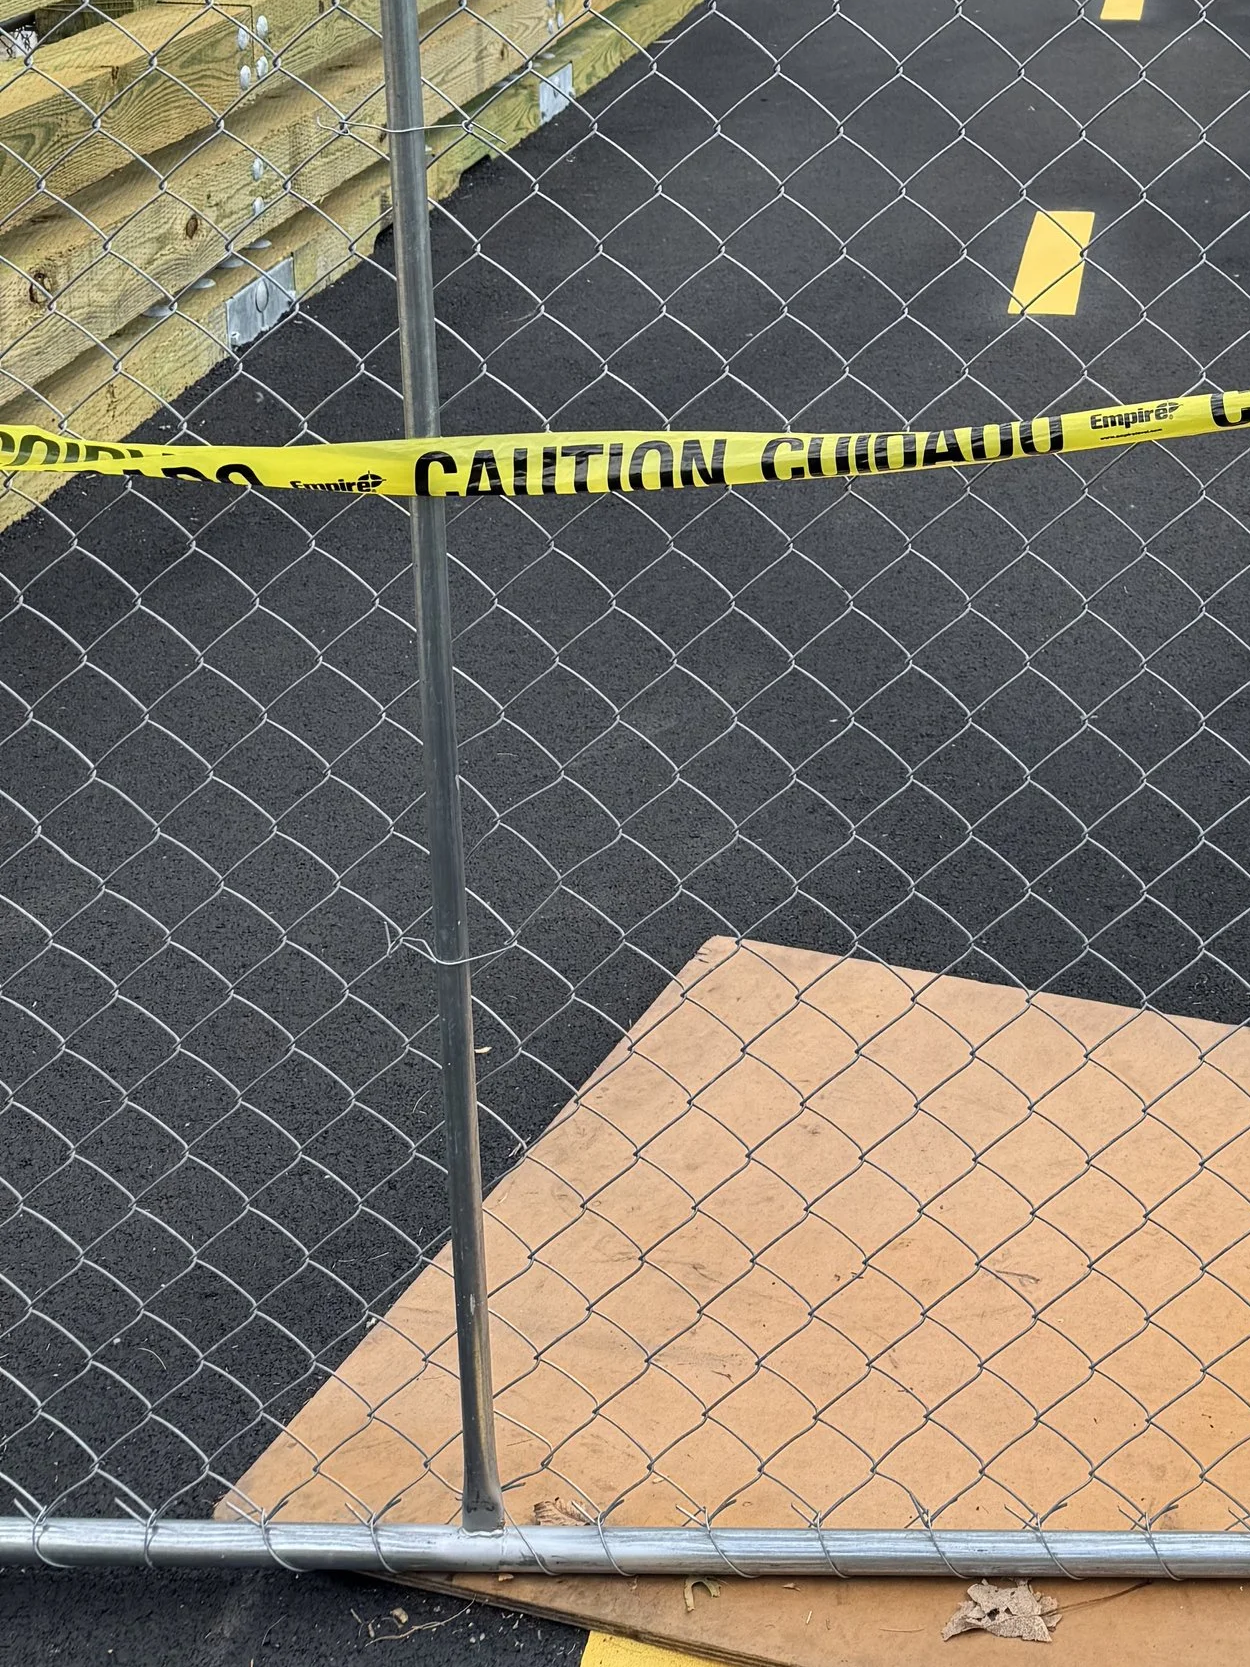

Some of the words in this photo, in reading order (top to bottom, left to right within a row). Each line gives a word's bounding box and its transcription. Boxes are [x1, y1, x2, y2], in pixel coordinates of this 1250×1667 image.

[1090, 406, 1169, 430] Empire
[414, 438, 728, 497] CAUTION
[760, 415, 1064, 481] CUIDADO
